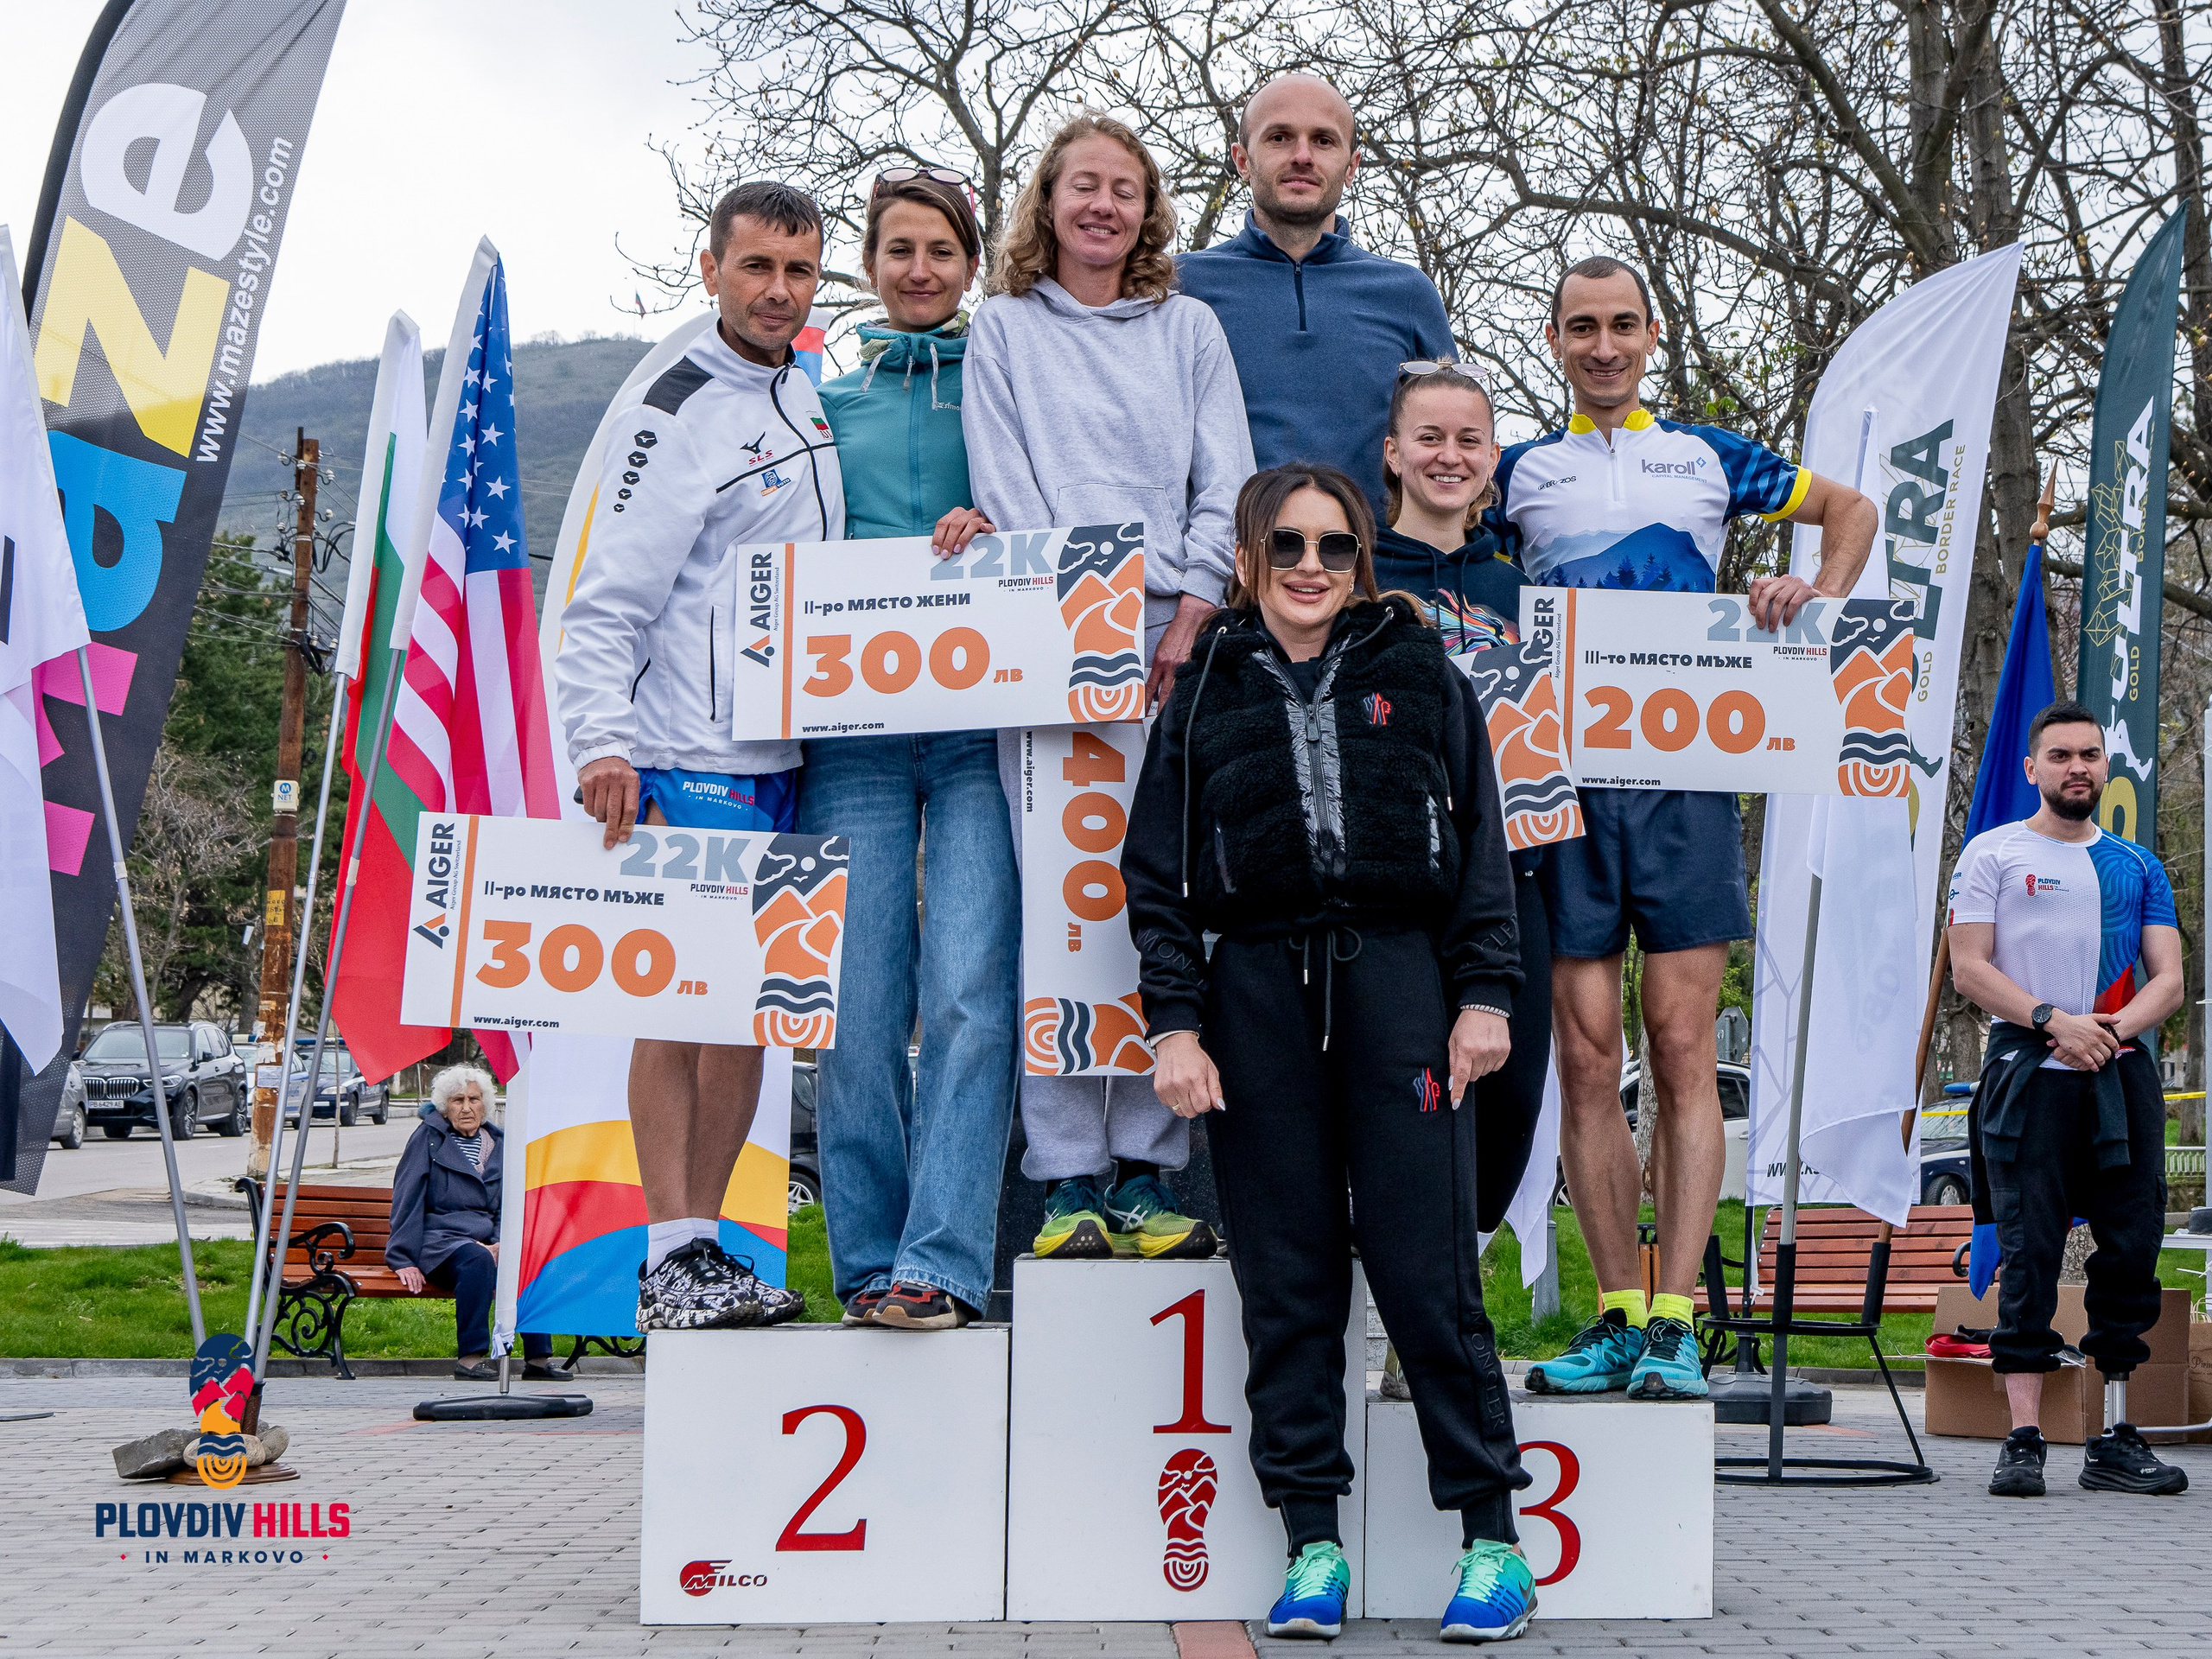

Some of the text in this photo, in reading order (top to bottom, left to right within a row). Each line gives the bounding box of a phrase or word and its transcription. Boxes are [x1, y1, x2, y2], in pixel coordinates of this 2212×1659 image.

[196, 137, 294, 462] www.mazestyle.com
[748, 450, 773, 465] SLS
[1642, 460, 1696, 475] karoll
[1546, 476, 1577, 488] BRZOS
[1674, 474, 1707, 484] MANAGEMENT
[1936, 443, 1966, 575] BORDER RACE
[1885, 418, 1954, 694] LTRA
[750, 551, 772, 631] AIGER
[998, 576, 1054, 588] PLOVDIV HILLS
[847, 596, 913, 611] МЯСТО
[916, 593, 970, 607] ЖЕНИ
[802, 626, 990, 697] 300
[1630, 652, 1693, 667] МЯСТО
[1696, 655, 1752, 669] МЪЖЕ
[1773, 646, 1827, 656] PLOVDIV HILLS
[1917, 651, 1933, 702] GOLD
[2129, 646, 2140, 702] GOLD
[802, 720, 885, 734] www.aiger.com
[1584, 685, 1765, 753] 200
[1025, 730, 1035, 813] www.aiger.com
[1581, 776, 1662, 787] www.aiger.com
[683, 781, 754, 806] PLOVDIV HILLS
[707, 797, 742, 810] MARKOVO
[1062, 731, 1128, 922] 400
[425, 823, 455, 909] AIGER
[620, 831, 751, 884] 22K
[531, 884, 599, 900] МЯСТО
[603, 890, 664, 906] МЪЖЕ
[690, 883, 748, 895] PLOVDIV HILLS
[475, 919, 677, 997] 300
[474, 1015, 560, 1029] www.aiger.com
[1149, 1287, 1233, 1434] 1
[775, 1403, 868, 1552] 2
[1518, 1440, 1581, 1587] 3
[682, 1573, 768, 1590] MILCO
